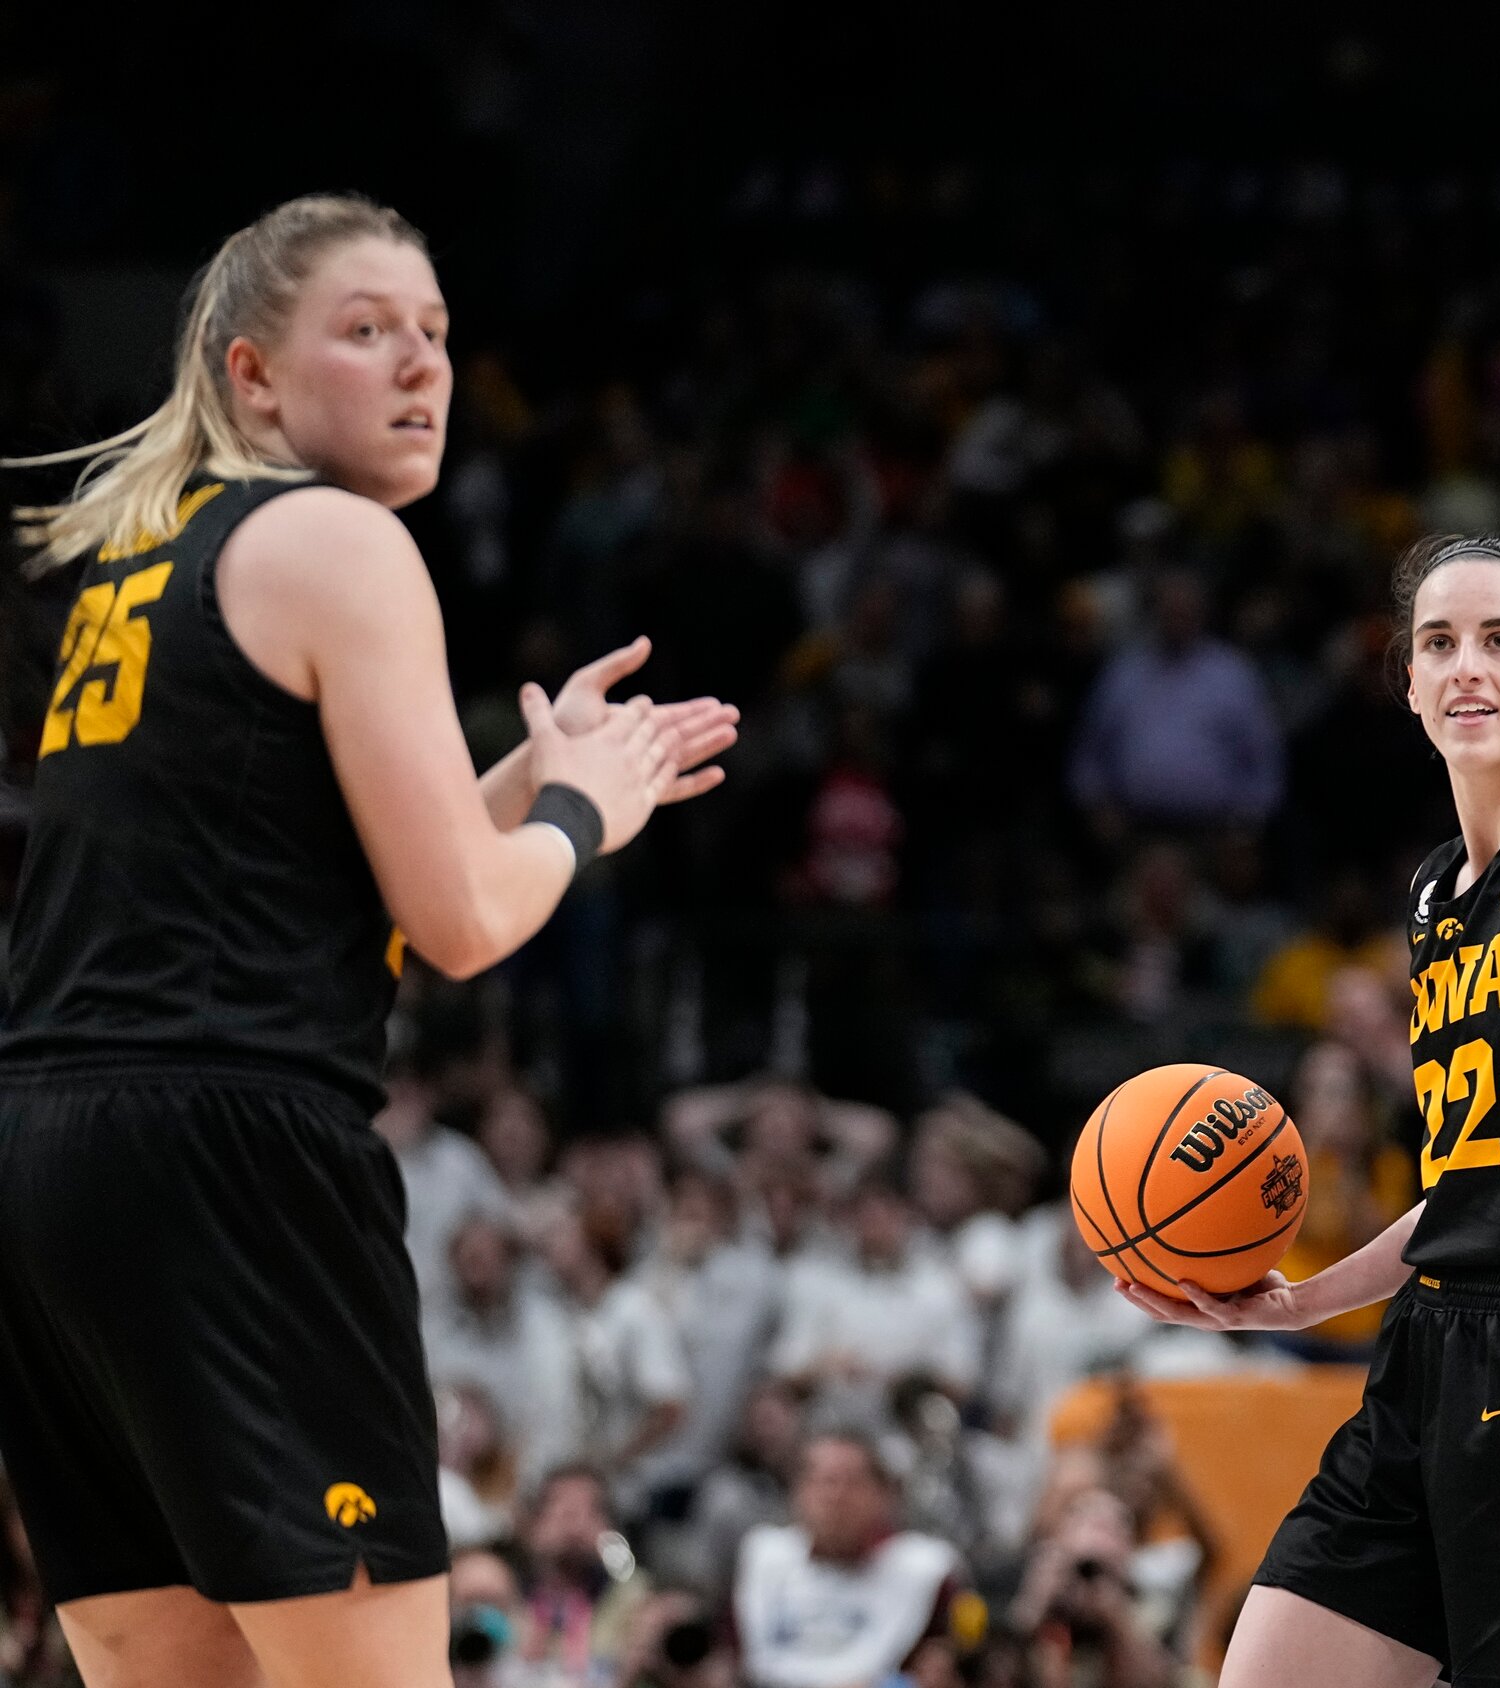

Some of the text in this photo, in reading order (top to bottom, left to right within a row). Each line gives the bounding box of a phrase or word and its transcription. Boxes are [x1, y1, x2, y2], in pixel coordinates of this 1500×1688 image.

[38, 561, 174, 760] 25
[1169, 1087, 1277, 1173] Wilson
[1237, 1129, 1254, 1146] EVO
[1263, 1178, 1287, 1206] FINAL
